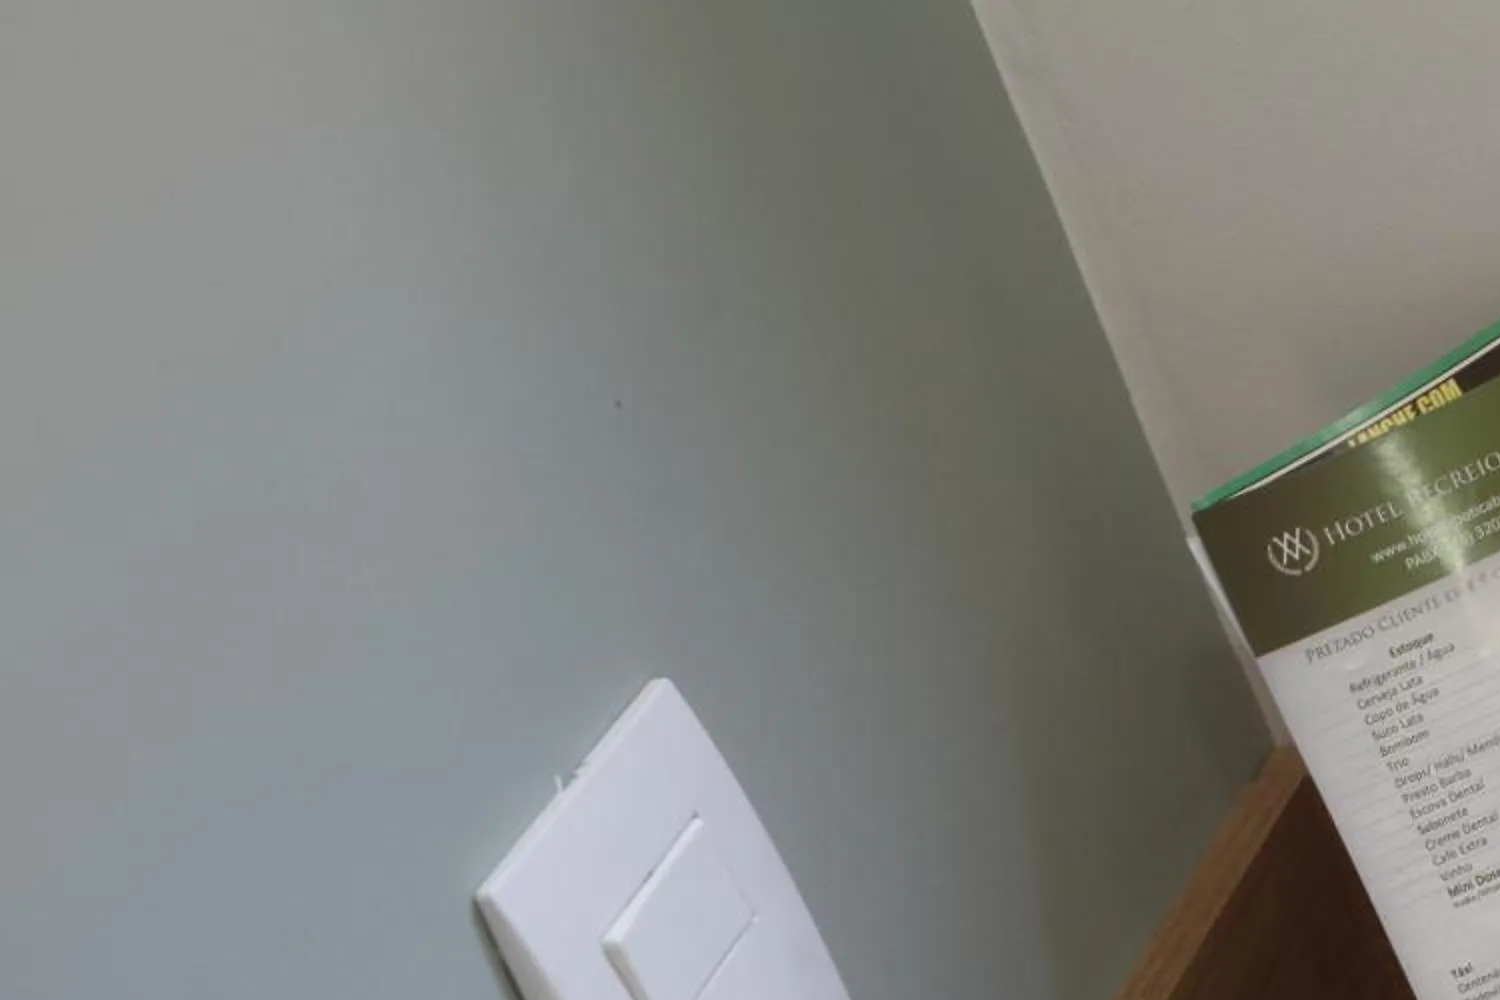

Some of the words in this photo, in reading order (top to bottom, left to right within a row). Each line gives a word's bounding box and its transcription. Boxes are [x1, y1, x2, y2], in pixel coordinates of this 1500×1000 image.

[1321, 492, 1405, 548] HOTEL
[1373, 590, 1441, 635] CLIENTE
[1387, 627, 1436, 662] Estoque
